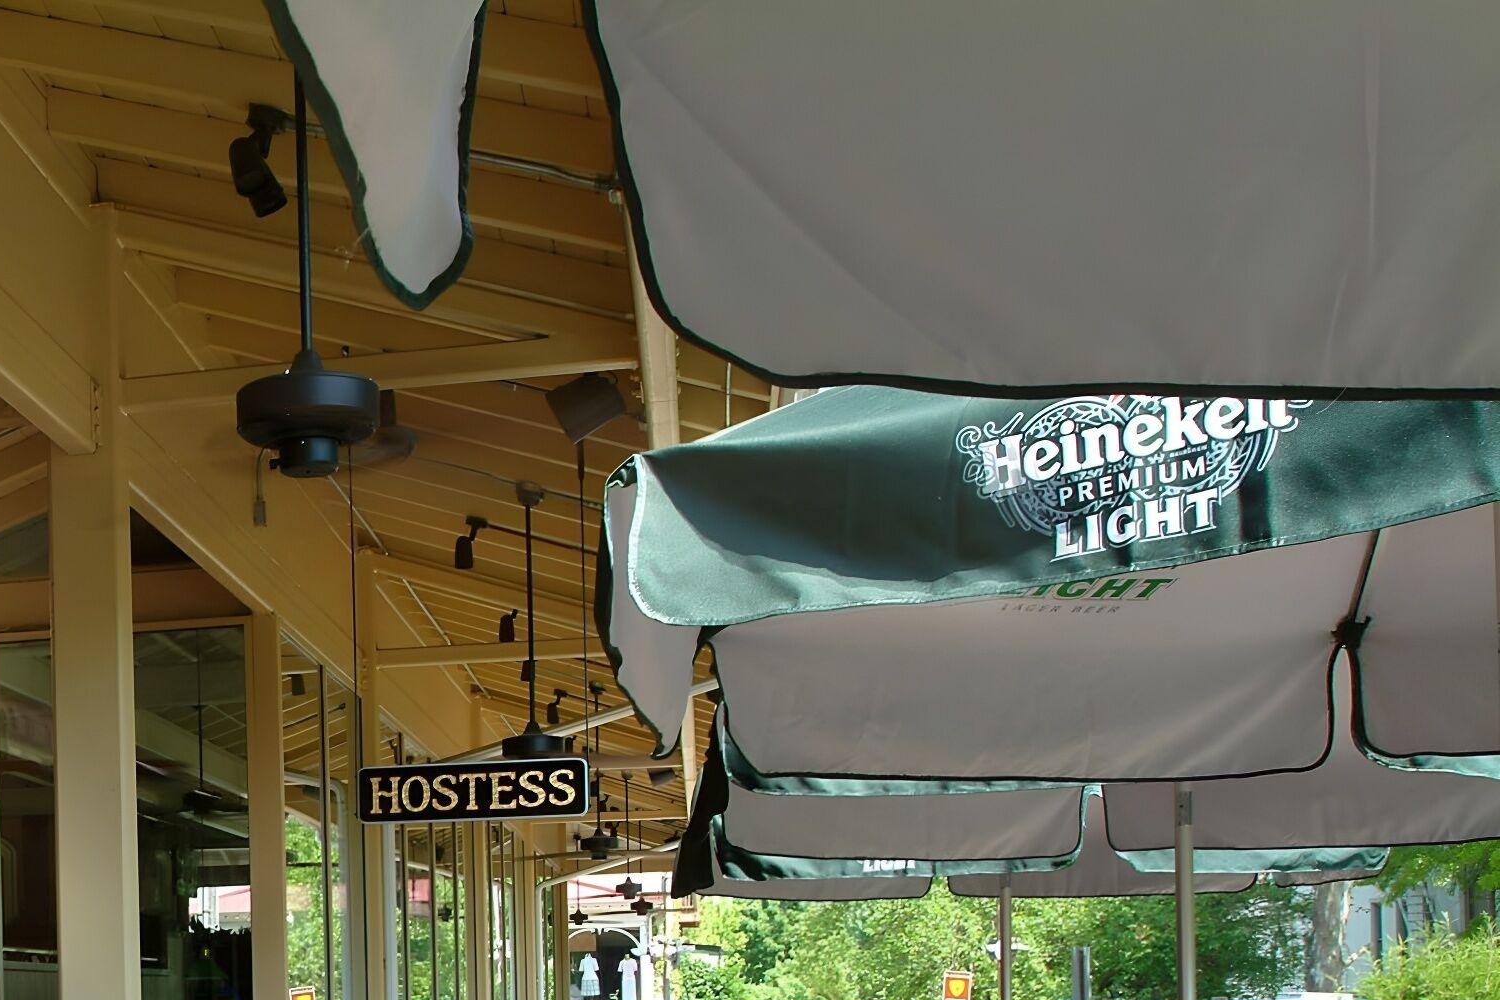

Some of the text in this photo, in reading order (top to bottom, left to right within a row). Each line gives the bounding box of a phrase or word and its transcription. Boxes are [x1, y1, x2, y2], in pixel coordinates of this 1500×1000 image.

[977, 397, 1293, 494] Heineken
[1059, 455, 1207, 507] PREMIUM
[1051, 487, 1222, 562] LIGHT
[1000, 578, 1178, 600] IGHT
[369, 768, 577, 815] HOSTESS
